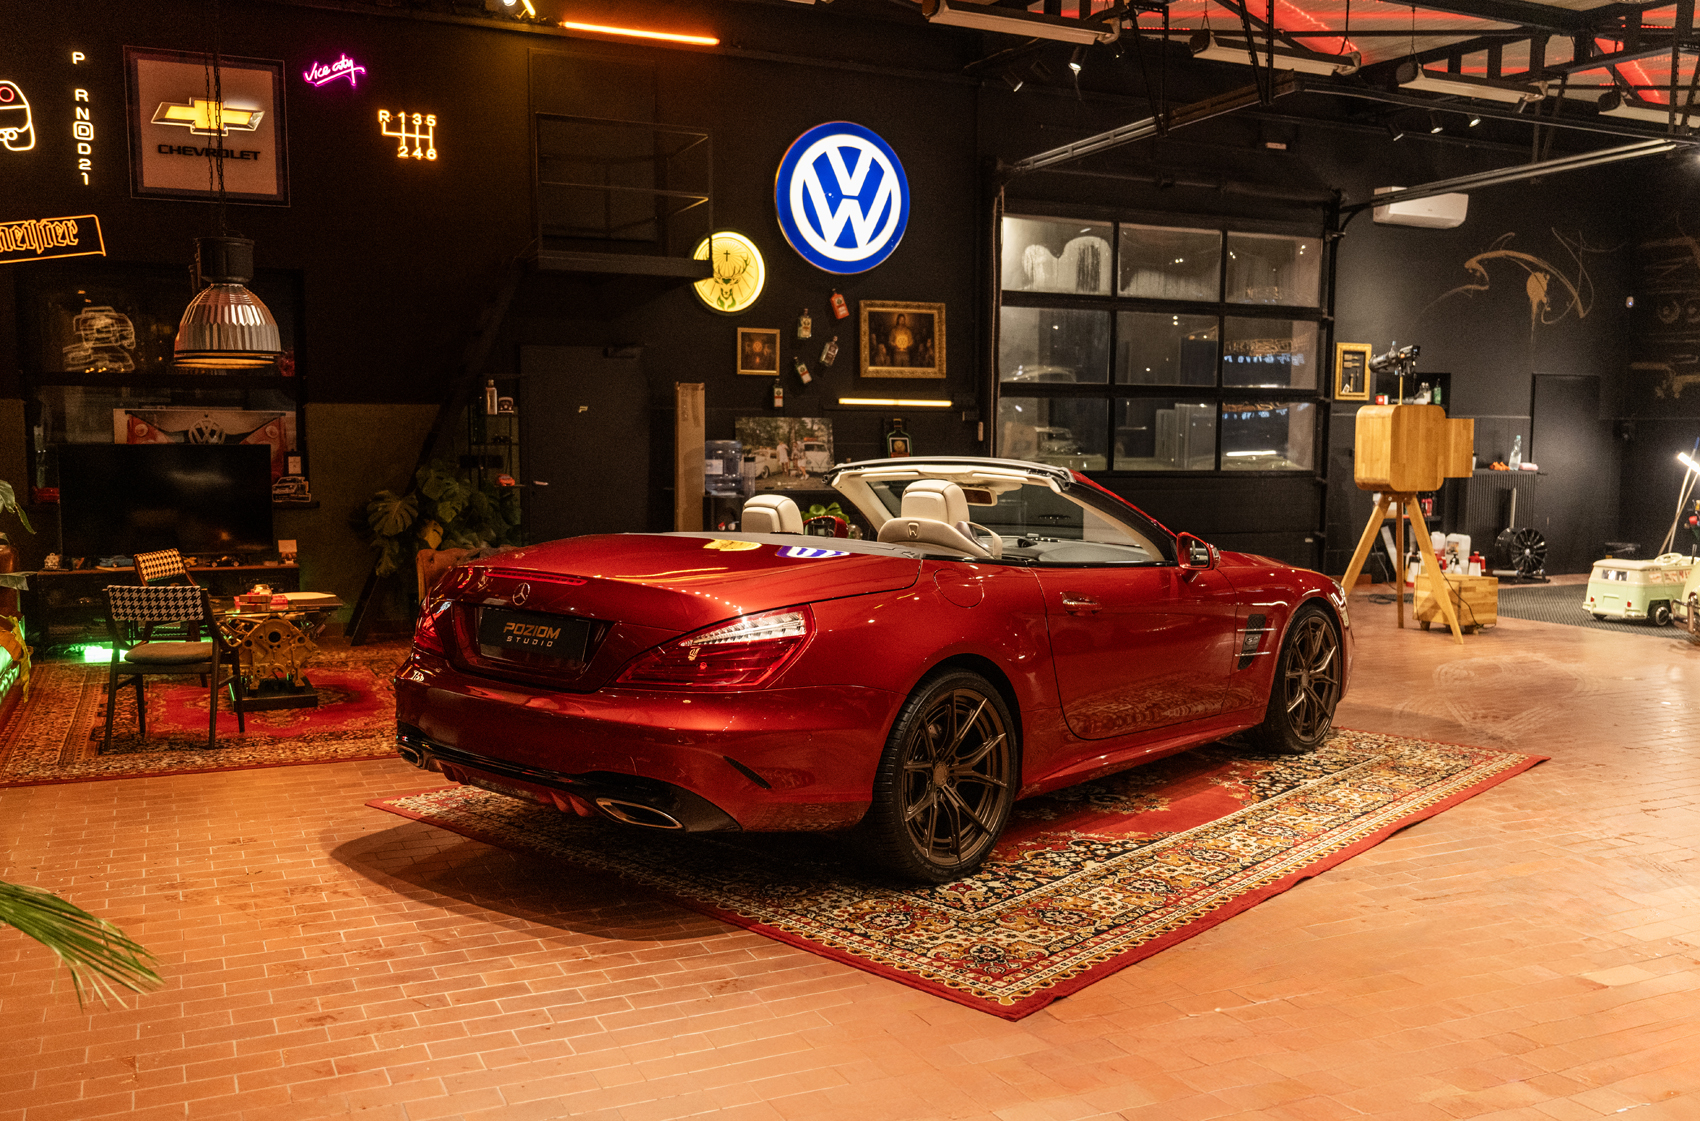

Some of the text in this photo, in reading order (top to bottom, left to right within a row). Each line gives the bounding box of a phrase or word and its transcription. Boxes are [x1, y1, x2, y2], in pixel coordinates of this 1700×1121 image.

[71, 51, 86, 65] P
[75, 88, 89, 102] R
[75, 106, 90, 121] N
[378, 109, 437, 127] R 1 3 5
[77, 142, 92, 155] D
[158, 144, 261, 160] CHEVROLET
[397, 145, 438, 161] 2 4 6
[78, 158, 92, 171] 2
[81, 172, 89, 186] 1
[503, 622, 562, 640] POZIOM
[506, 635, 554, 648] STUDIO
